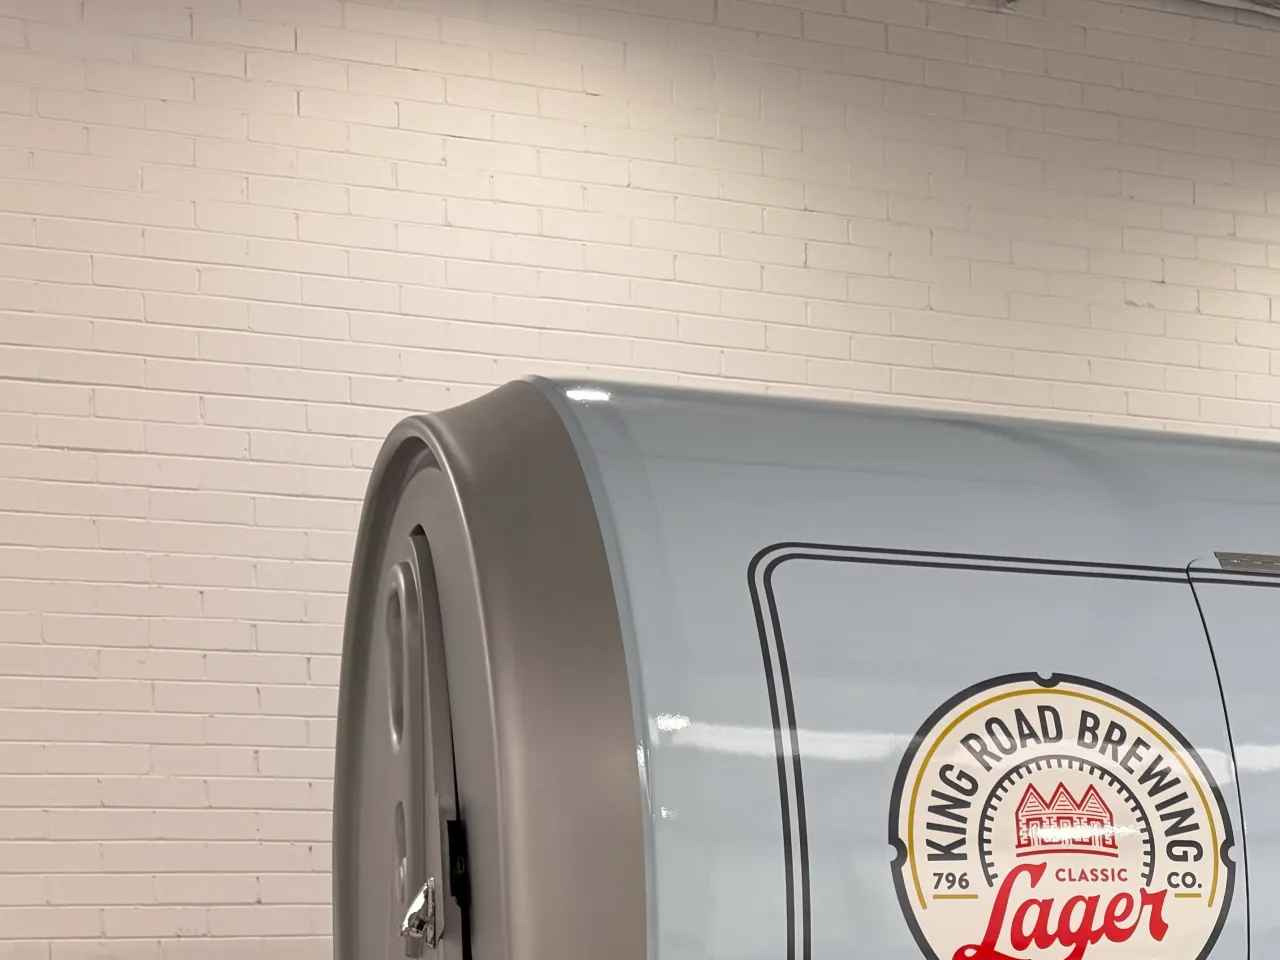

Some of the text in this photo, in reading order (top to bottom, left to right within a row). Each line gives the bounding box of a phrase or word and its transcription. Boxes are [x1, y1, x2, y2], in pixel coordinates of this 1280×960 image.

[925, 704, 1204, 889] KING ROAD BREWING CO.
[932, 872, 970, 890] 796
[1055, 868, 1129, 883] CLASSIC
